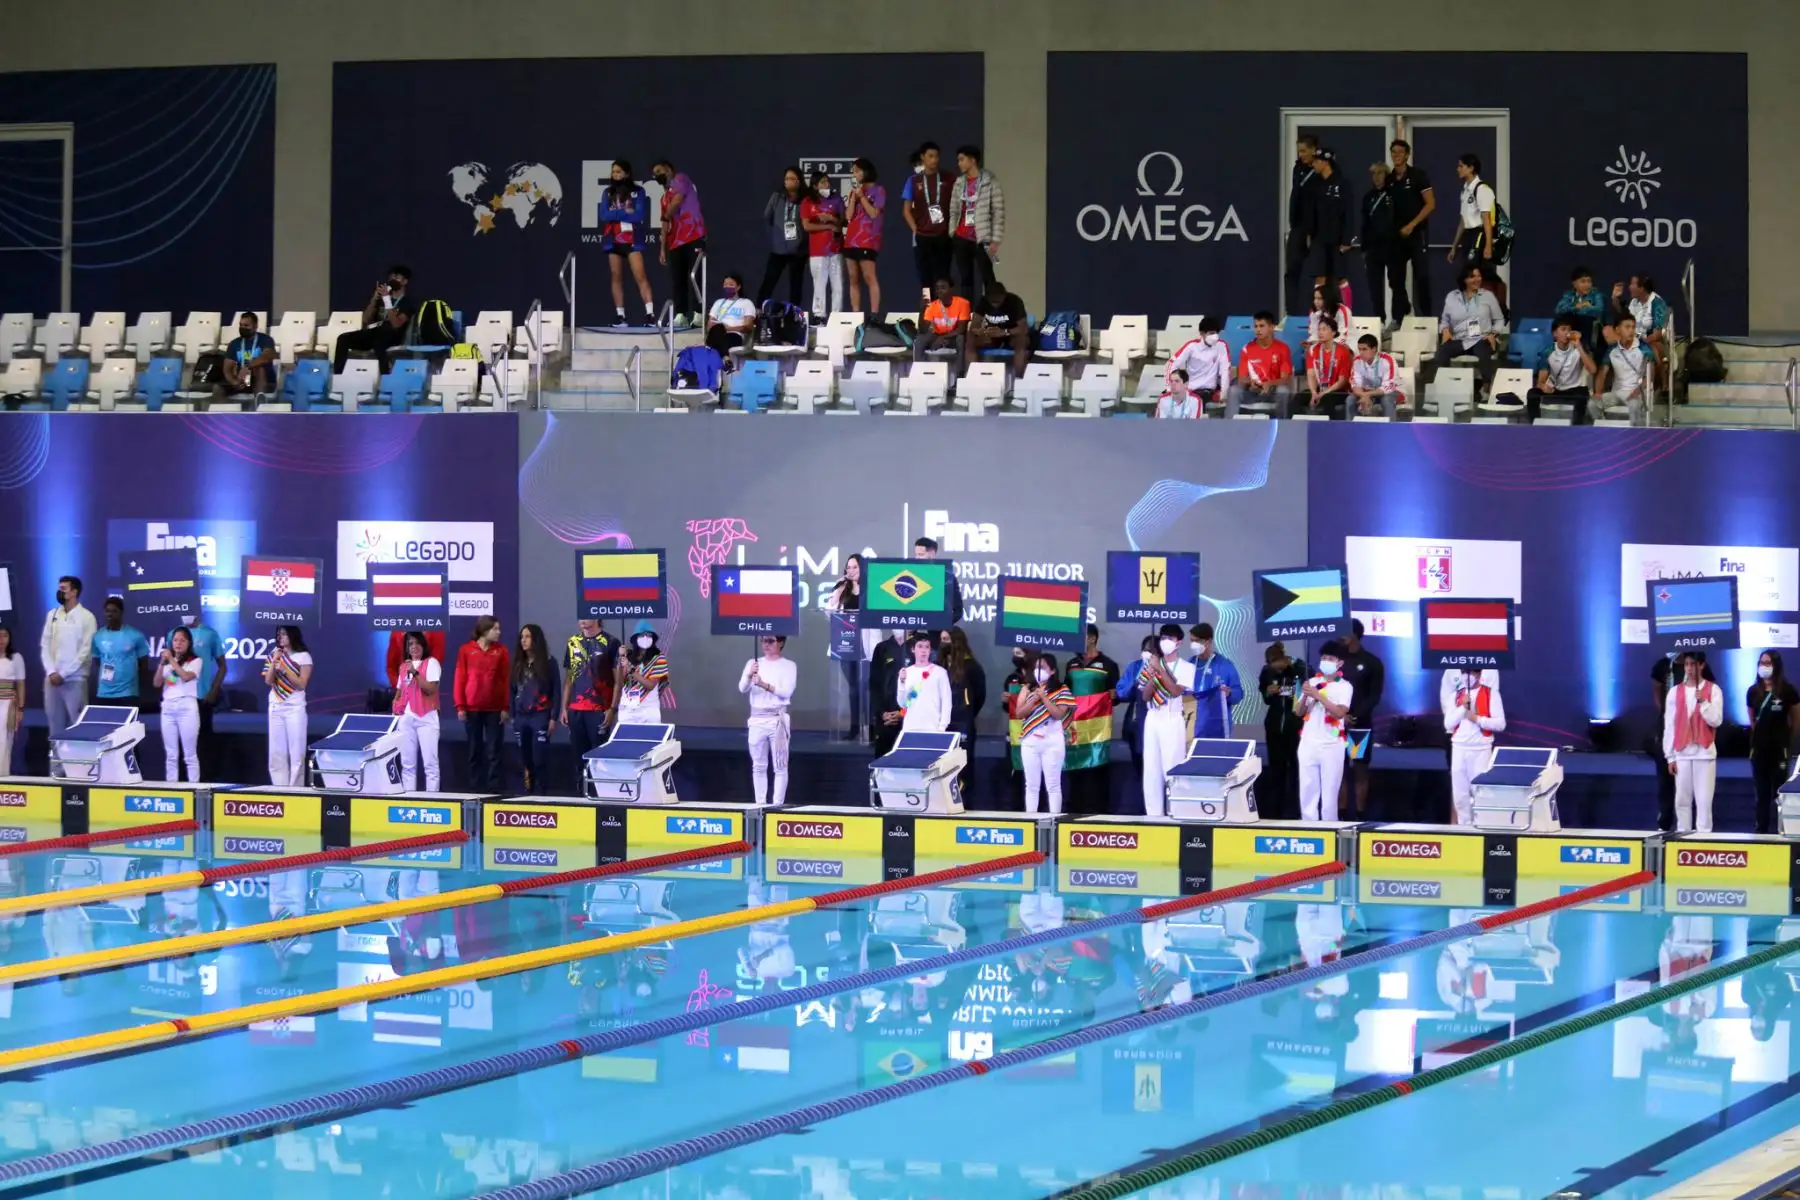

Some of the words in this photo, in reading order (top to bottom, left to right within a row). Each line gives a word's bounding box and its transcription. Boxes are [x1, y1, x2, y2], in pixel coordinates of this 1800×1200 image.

[804, 163, 855, 173] FDP
[1076, 204, 1250, 242] OMEGA
[953, 561, 1000, 580] ORLD
[1720, 557, 1746, 573] Fina
[137, 603, 189, 615] CURACAO
[590, 606, 654, 615] COLOMBIA
[1118, 609, 1187, 619] BARBADOS
[255, 611, 304, 622] CROATIA
[373, 618, 412, 627] COSTA
[416, 618, 442, 627] RICA
[882, 616, 927, 625] BRASIL
[738, 622, 773, 631] CHILE
[1272, 624, 1336, 636] BAHAMAS
[1015, 634, 1065, 646] BOLIVIA
[1674, 637, 1716, 647] ARUBA
[1440, 656, 1497, 665] AUSTRIA
[128, 755, 135, 770] 2
[389, 764, 396, 781] 3
[619, 782, 634, 796] 4
[0, 792, 26, 805] EGA
[154, 797, 176, 812] Fina
[905, 792, 920, 806] 5
[239, 804, 283, 815] OMEGA
[420, 809, 442, 824] Fina
[510, 813, 556, 826] OMEGA
[700, 819, 723, 833] Fina
[794, 824, 841, 837] OMEGA
[990, 831, 1015, 844] Fina
[1087, 834, 1137, 847] OMEGA
[1290, 838, 1315, 853] Fina
[1390, 842, 1440, 856] OMEGA
[1595, 849, 1621, 863] Fina
[1695, 852, 1746, 866] OMEGA
